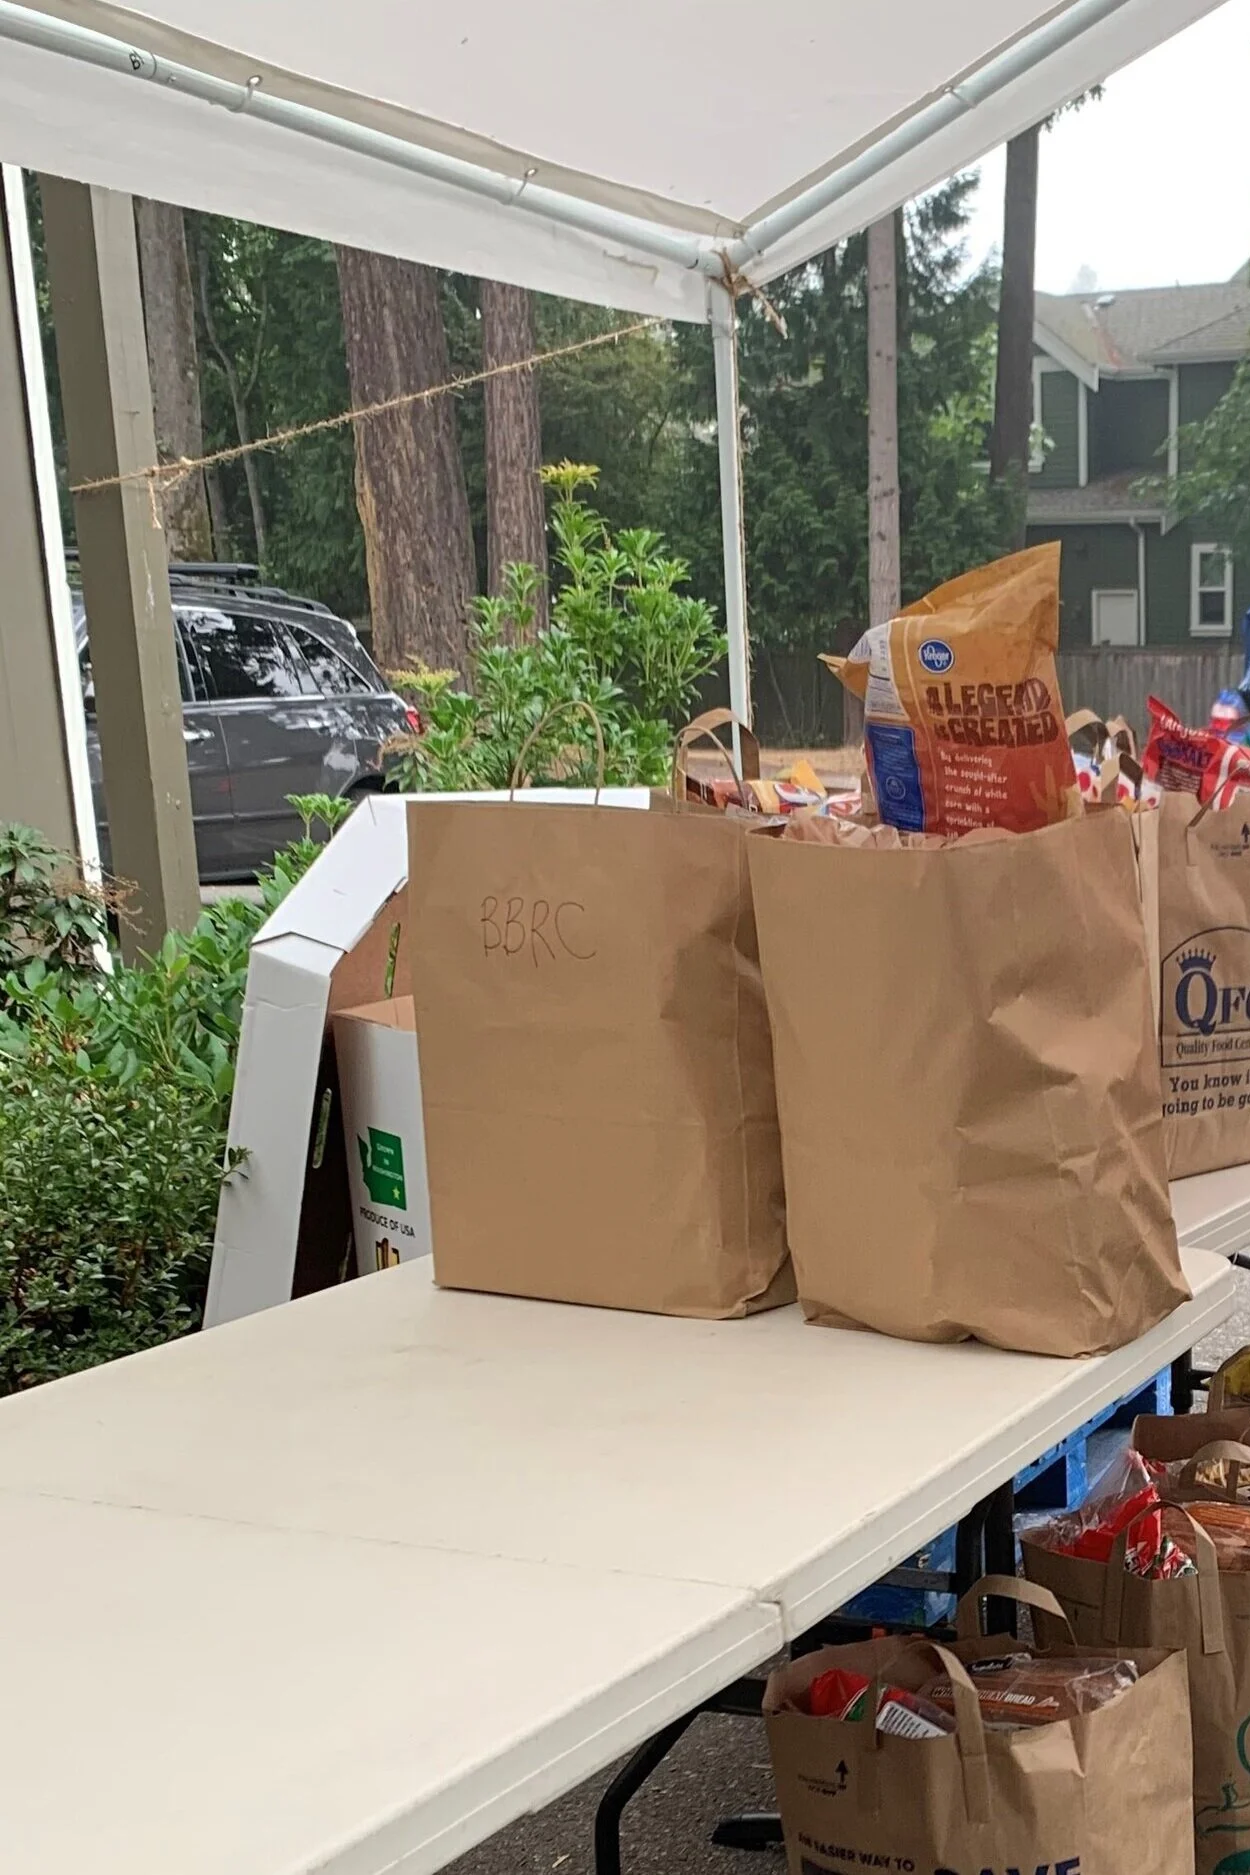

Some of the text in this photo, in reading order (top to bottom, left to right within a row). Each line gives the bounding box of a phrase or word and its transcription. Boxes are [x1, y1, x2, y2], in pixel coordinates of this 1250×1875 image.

[926, 686, 944, 716] A
[944, 678, 1051, 717] LEGEND
[947, 711, 1059, 748] CREATED
[944, 766, 958, 777] the
[945, 784, 971, 795] crunch
[966, 802, 982, 813] with
[480, 895, 597, 968] BBRC
[1176, 1040, 1208, 1058] Quality
[1212, 1038, 1233, 1052] Food
[1169, 1075, 1199, 1092] You
[1203, 1074, 1242, 1090] know
[1202, 1096, 1215, 1110] to
[1217, 1092, 1235, 1109] be
[360, 1206, 416, 1239] PRODUCE OF USA
[1004, 1692, 1036, 1706] BREAD
[859, 1852, 890, 1868] WAY
[894, 1858, 915, 1872] TO
